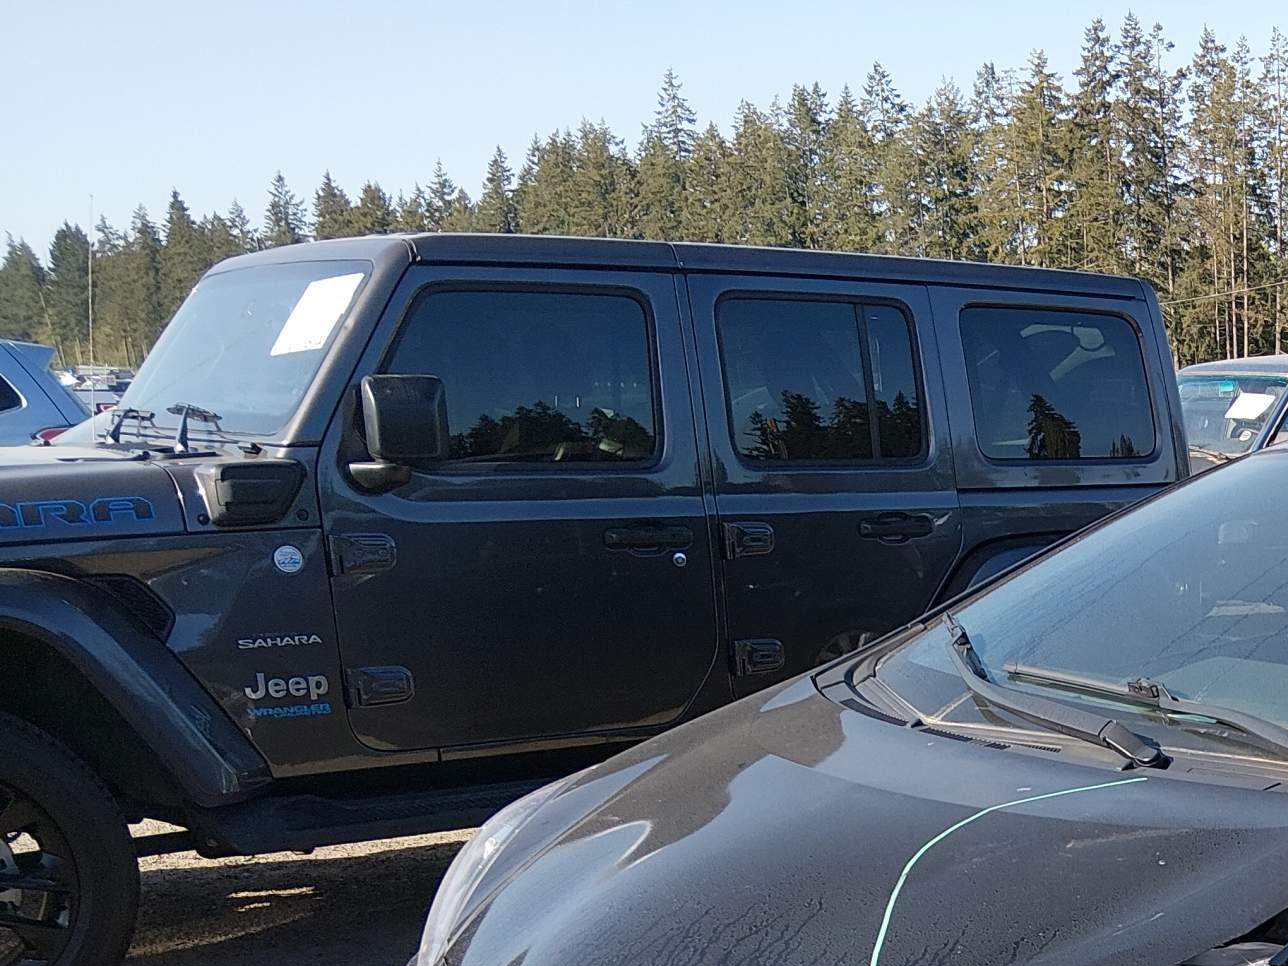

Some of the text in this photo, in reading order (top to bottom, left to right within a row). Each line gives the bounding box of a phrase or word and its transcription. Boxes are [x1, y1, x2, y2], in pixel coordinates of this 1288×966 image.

[237, 634, 323, 649] SAHARA
[244, 672, 329, 700] Jeep
[246, 703, 331, 717] WRANGLER
